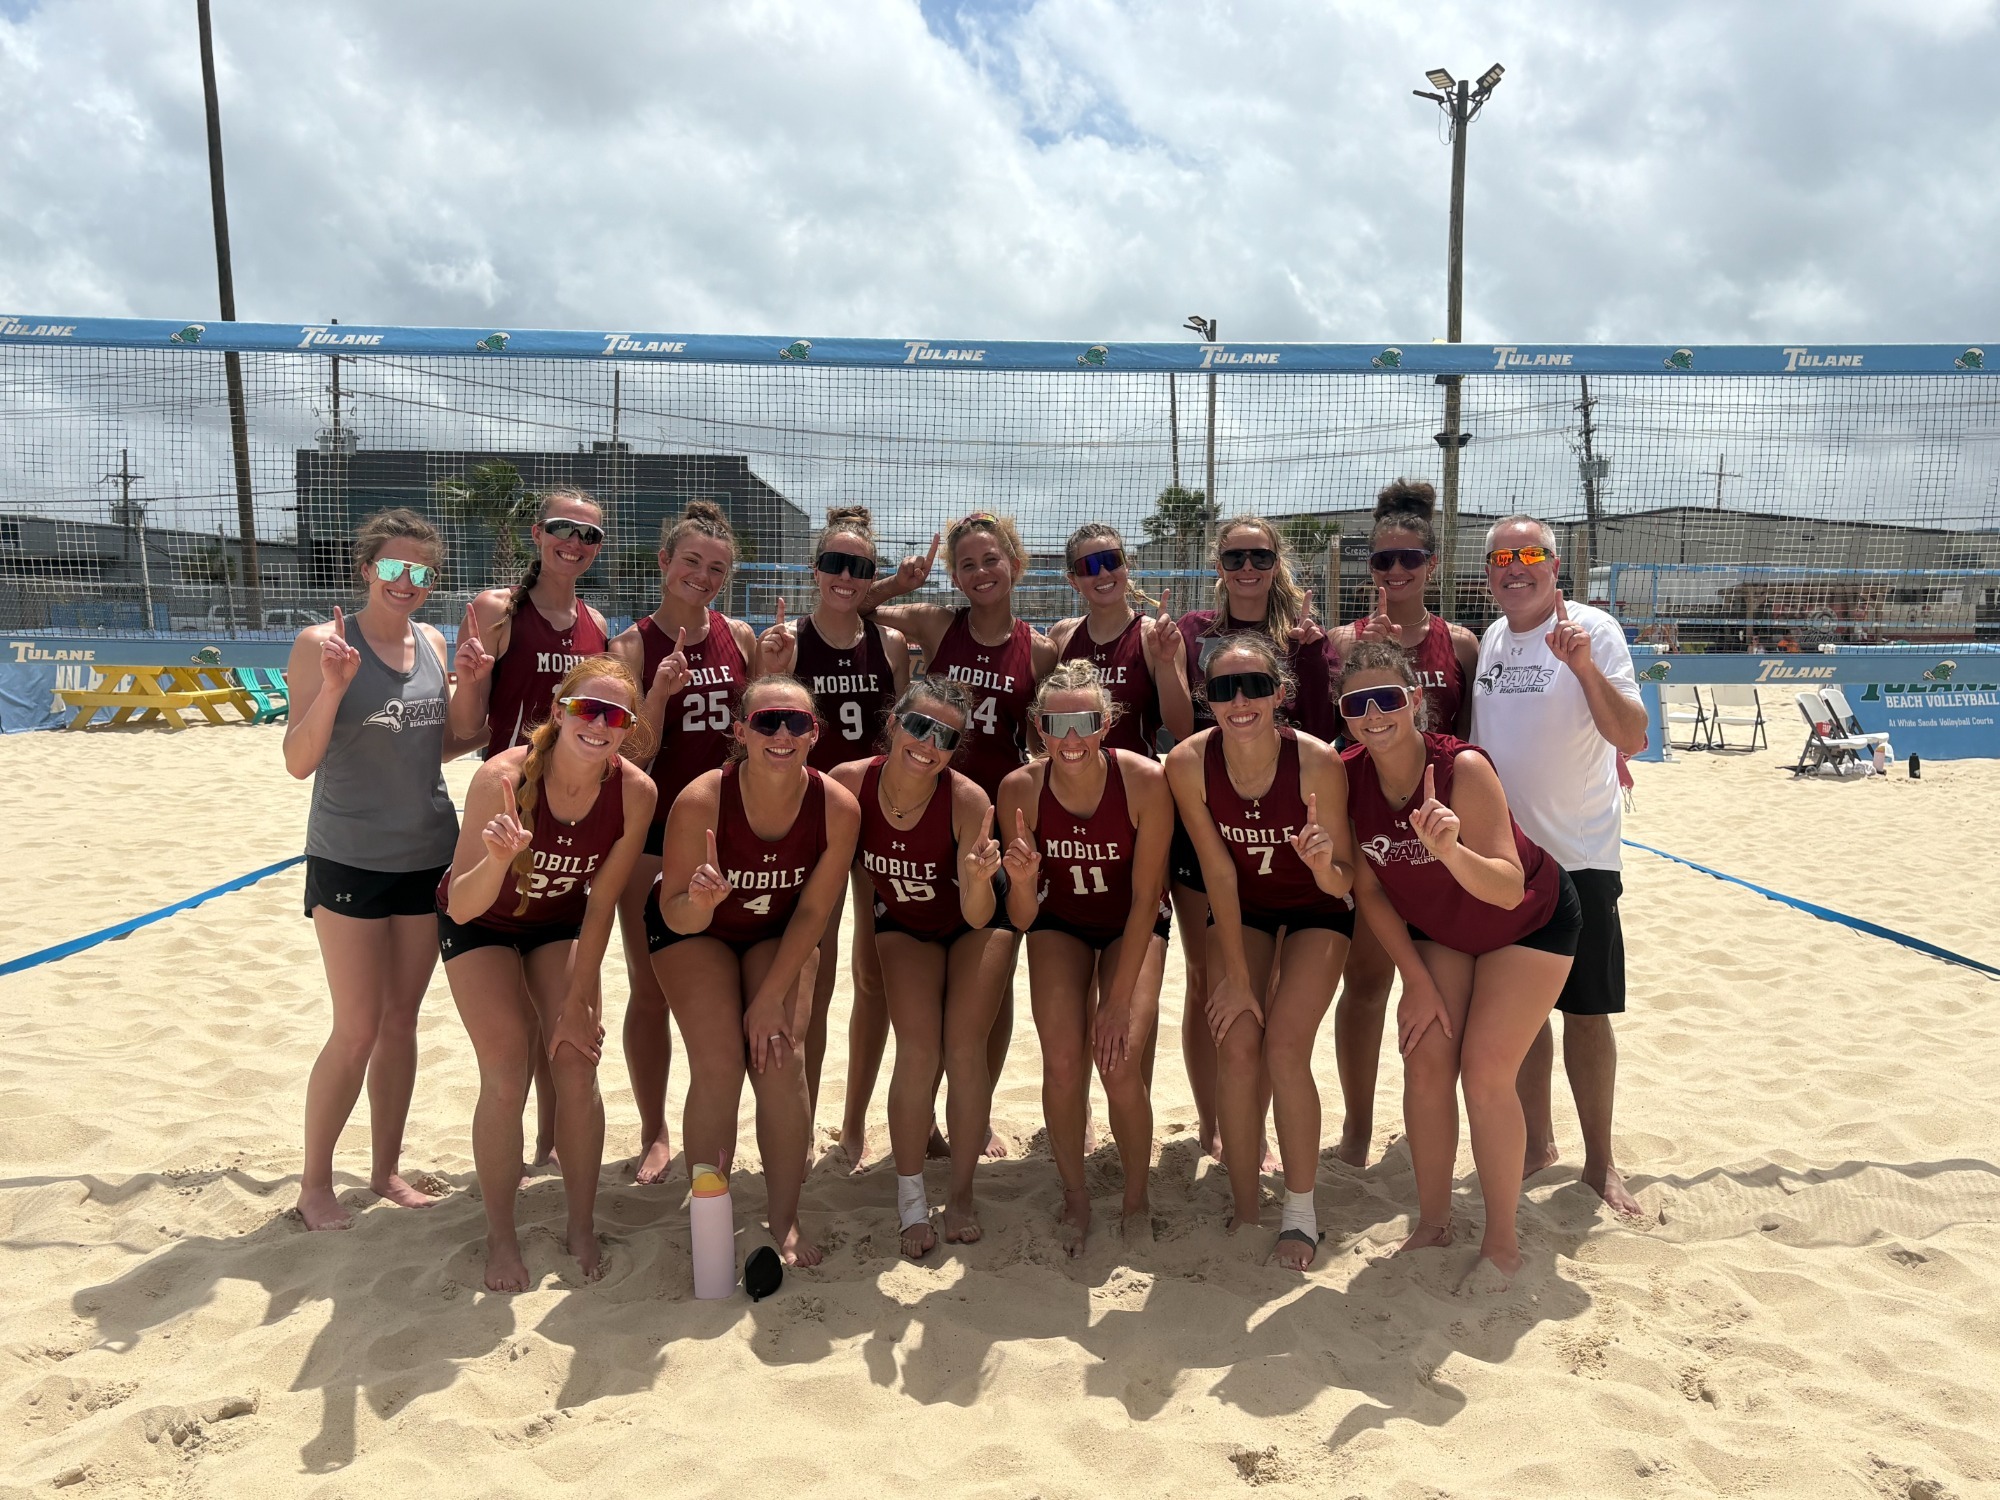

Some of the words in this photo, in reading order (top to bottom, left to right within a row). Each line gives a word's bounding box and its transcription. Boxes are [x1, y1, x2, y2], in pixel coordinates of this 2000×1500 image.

[0, 316, 77, 337] TULANE
[297, 327, 384, 348] TULANE
[602, 334, 687, 355] TULANE
[904, 341, 986, 364] TULANE
[1199, 346, 1280, 368] TULANE
[1493, 347, 1573, 370] TULANE
[1783, 348, 1863, 371] TULANE
[10, 642, 95, 662] TULANE
[536, 652, 585, 674] MOBI
[687, 666, 734, 687] BILE
[948, 665, 1015, 693] MOBILE
[1090, 666, 1127, 684] BILE
[1415, 671, 1447, 688] ILE
[1496, 669, 1555, 688] RAMS
[1755, 660, 1837, 682] TULANE
[813, 674, 879, 694] MOBILE
[402, 701, 447, 722] RAM
[682, 690, 730, 732] 25
[1885, 695, 1923, 709] BEACH
[1926, 692, 2000, 708] VOLLEYBALL
[840, 701, 863, 740] 9
[1889, 719, 1896, 727] At
[1898, 719, 1917, 728] White
[1918, 718, 1938, 727] Sands
[1939, 717, 1970, 728] Volleyball
[1972, 717, 1994, 726] Courts
[1218, 821, 1295, 844] MOBILE
[530, 847, 599, 874] OBILE
[1046, 839, 1121, 861] MOBILE
[1246, 846, 1275, 875] 7
[1387, 843, 1434, 862] RAM
[863, 850, 937, 880] MOBILE
[514, 873, 579, 899] 23
[727, 867, 805, 889] MOBILE
[1069, 866, 1109, 895] 11
[889, 878, 937, 902] 15
[743, 894, 772, 914] 4
